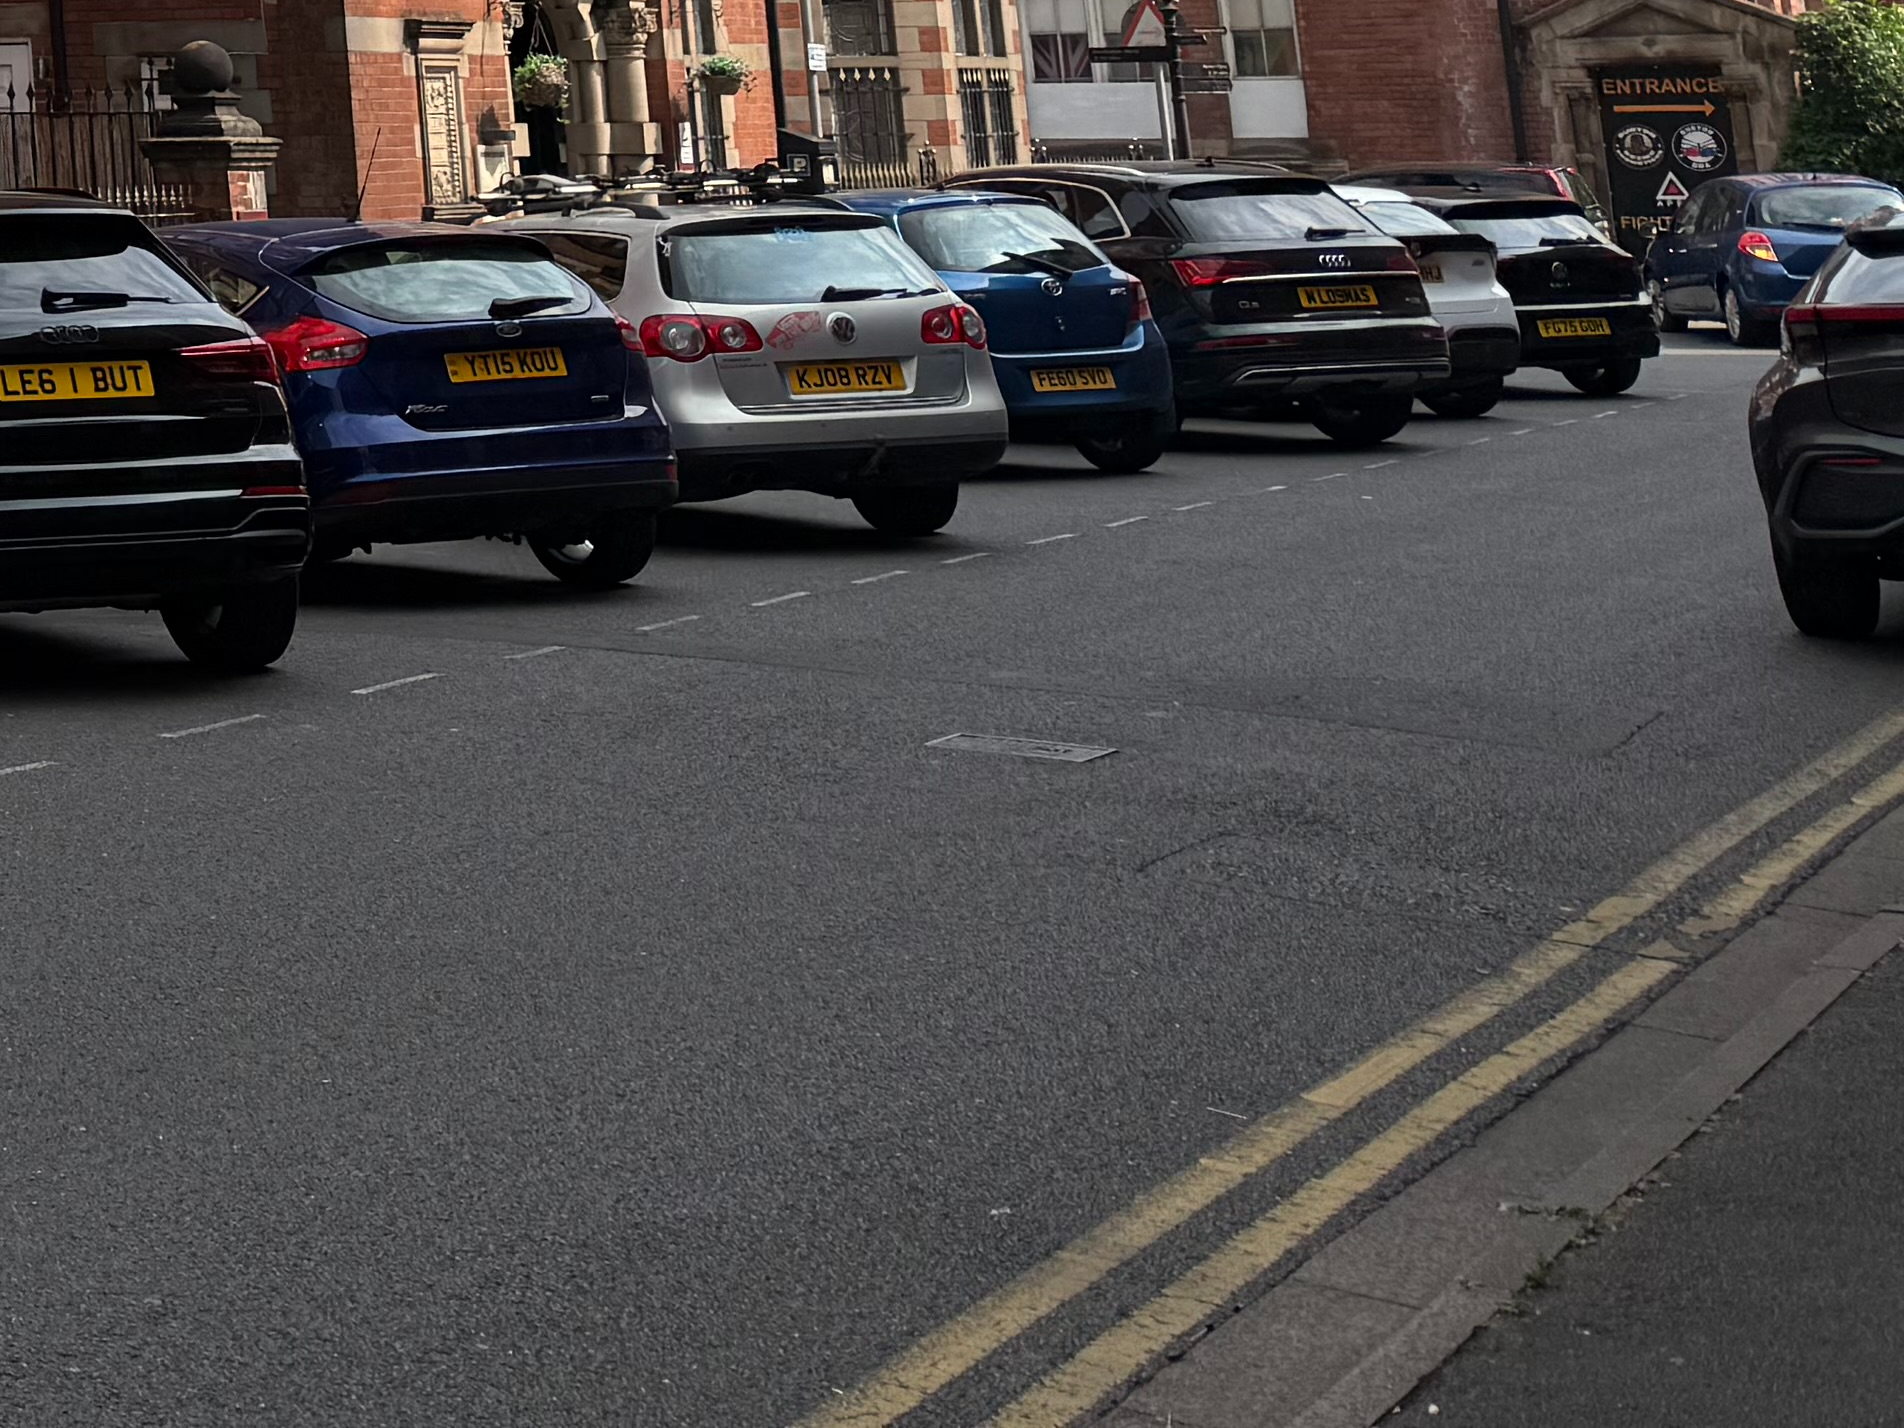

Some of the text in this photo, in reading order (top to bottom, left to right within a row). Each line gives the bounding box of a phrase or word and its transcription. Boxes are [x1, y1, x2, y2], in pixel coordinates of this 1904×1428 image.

[1601, 77, 1724, 95] ENTRANCE
[464, 349, 559, 377] YT15 KOU
[90, 365, 144, 393] BUT
[795, 364, 892, 389] KJ08 RZV
[1036, 369, 1077, 387] FE60
